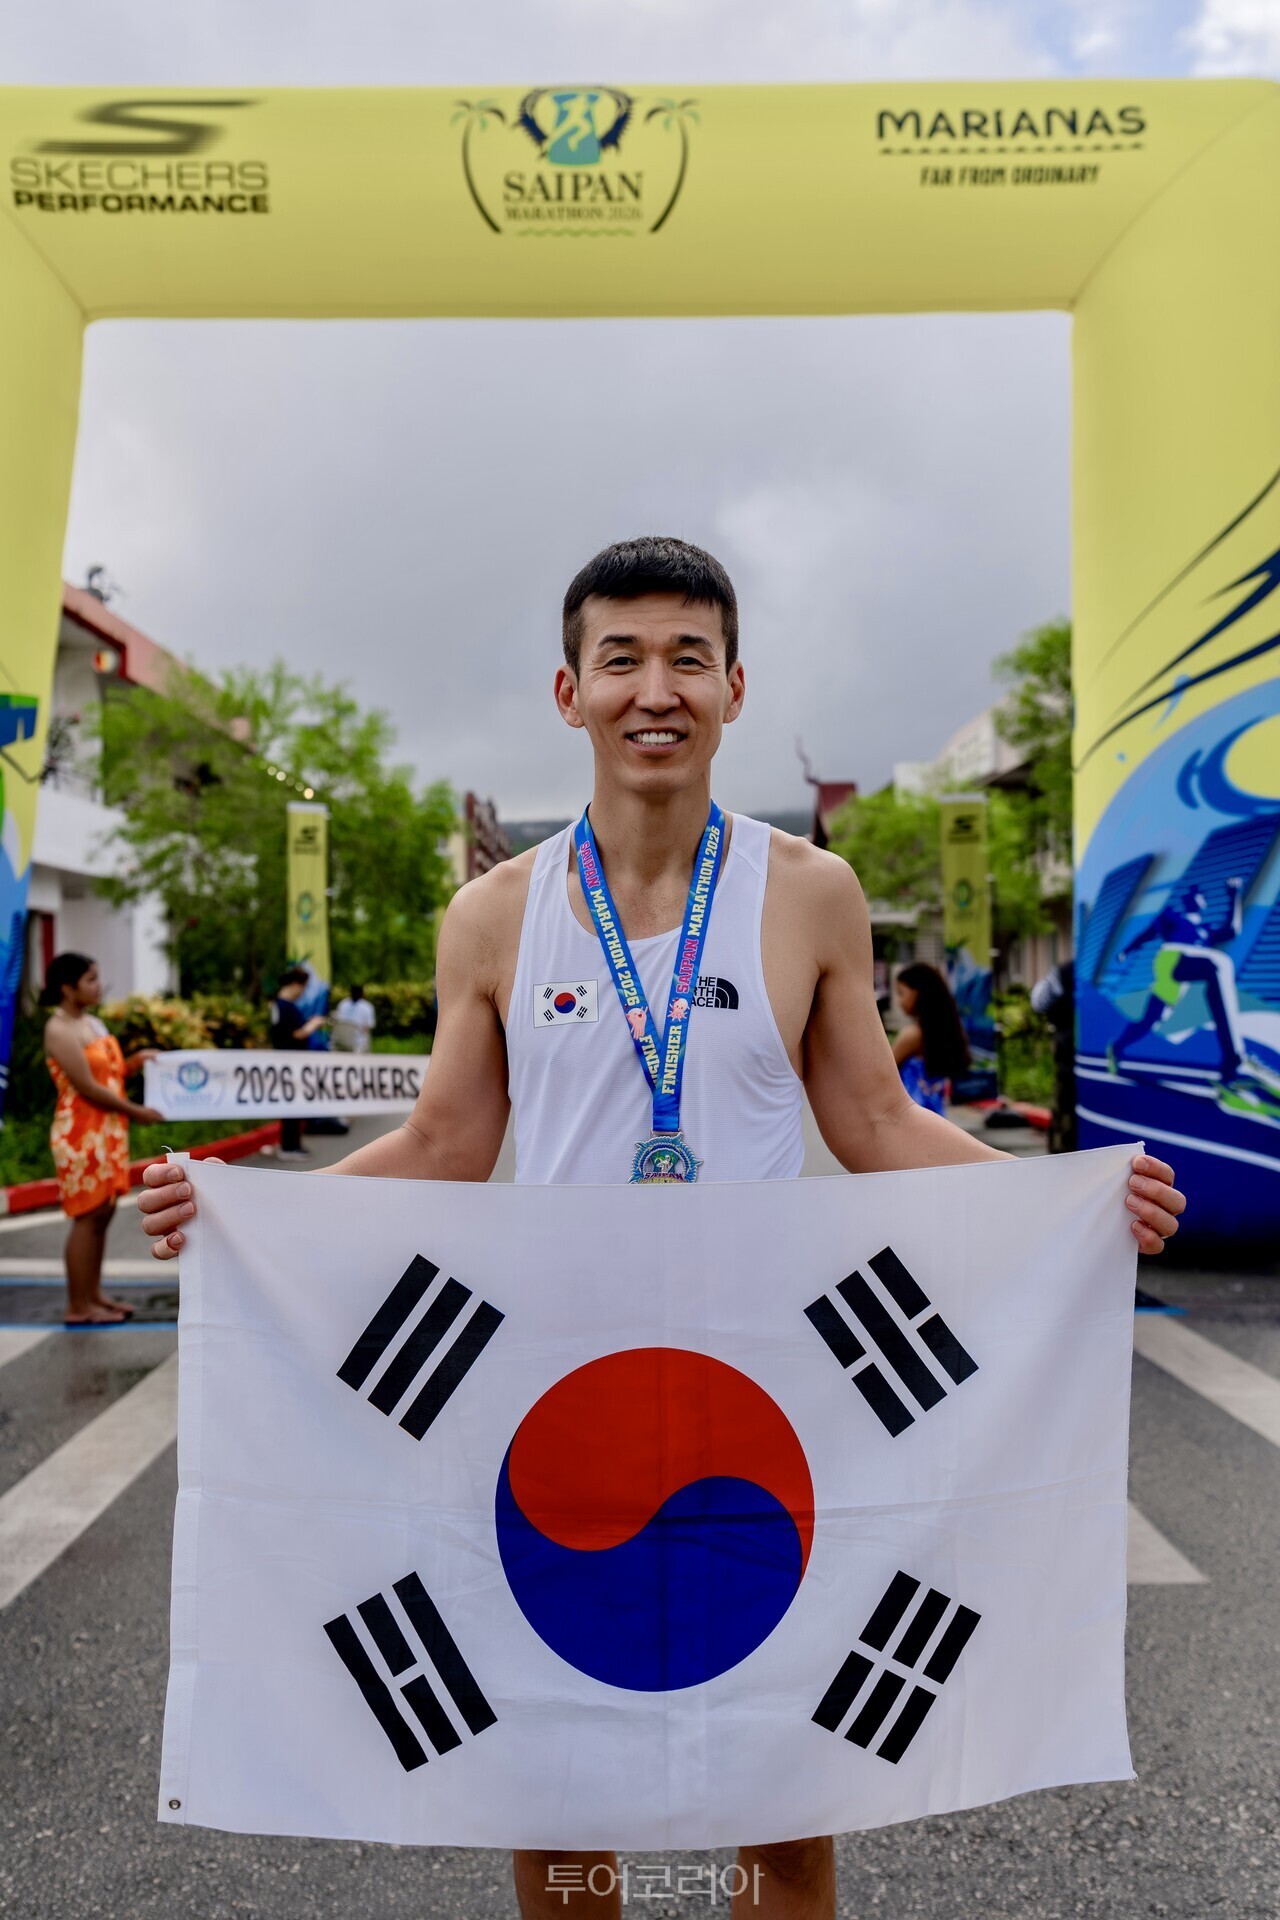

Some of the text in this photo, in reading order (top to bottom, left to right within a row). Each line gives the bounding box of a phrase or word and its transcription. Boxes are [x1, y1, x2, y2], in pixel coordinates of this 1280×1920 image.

[877, 106, 1146, 139] MARIANAS
[10, 157, 268, 191] SKECHERS
[503, 170, 643, 202] SAIPAN
[920, 163, 1100, 187] FAR FROM ORDINARY
[14, 189, 269, 213] PERFORMANCE
[505, 206, 603, 219] MARATHON
[580, 841, 640, 1007] SAIPAN MARATHON 2026
[677, 826, 721, 993] SAIPAN MARATHON 2026
[697, 976, 716, 987] HE
[691, 996, 714, 1008] ACE
[661, 1025, 682, 1094] FINISHER
[234, 1065, 420, 1104] 2026 SKECHERS
